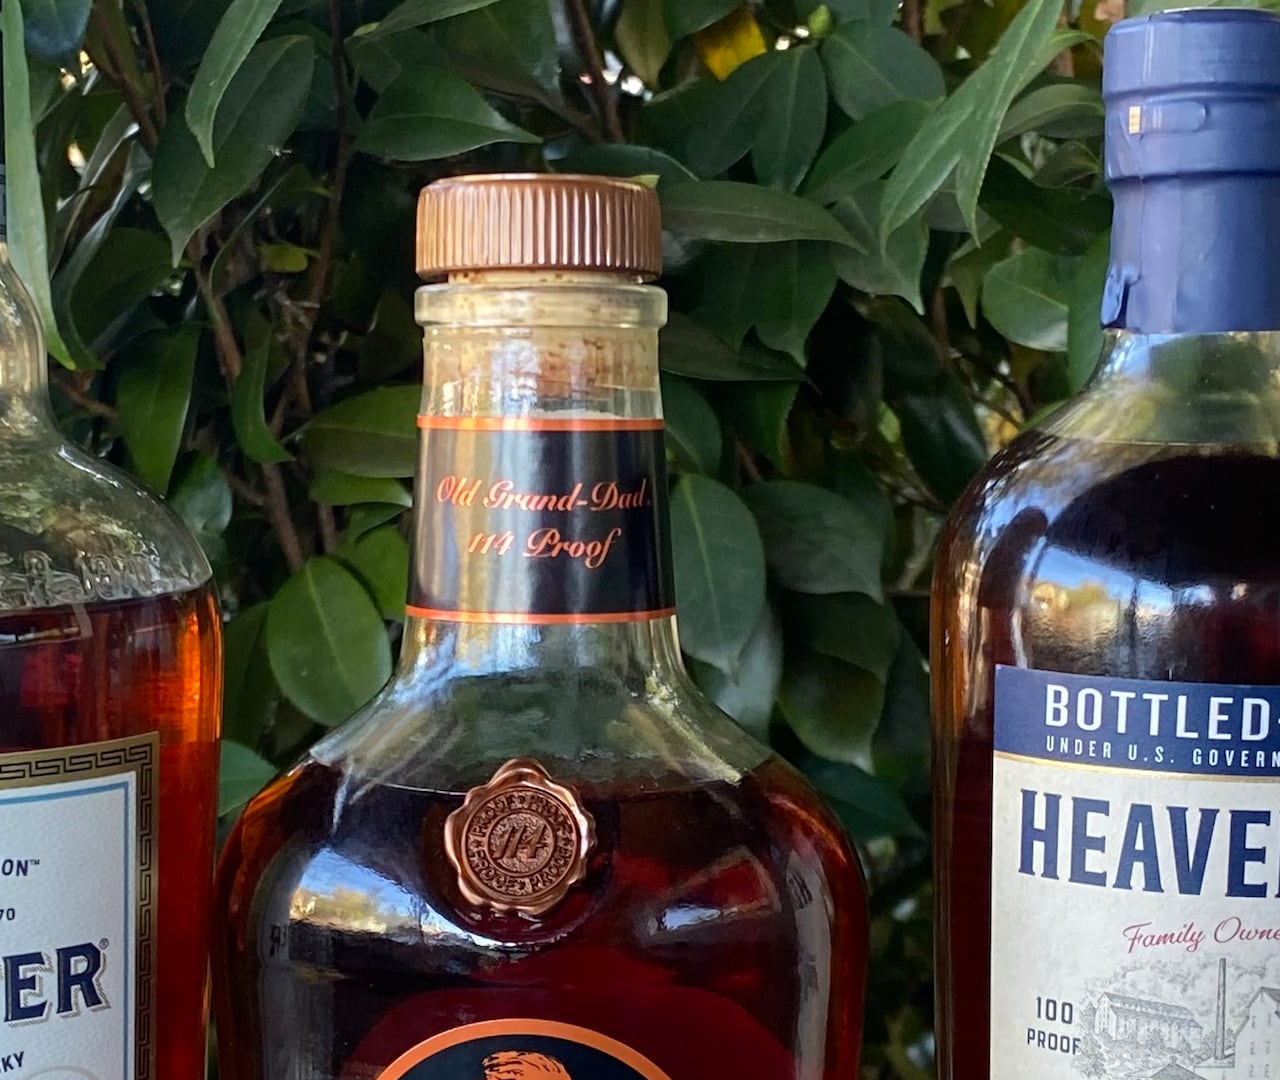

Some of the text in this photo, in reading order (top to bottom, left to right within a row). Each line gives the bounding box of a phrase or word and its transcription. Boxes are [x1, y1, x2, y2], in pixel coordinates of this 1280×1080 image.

[436, 475, 482, 507] Old
[469, 527, 622, 569] 114 Proof
[1046, 735, 1112, 759] UNDER
[1128, 745, 1175, 764] U.S.
[1122, 922, 1206, 954] Family
[1036, 995, 1074, 1025] 100
[1027, 1029, 1082, 1056] PROOF
